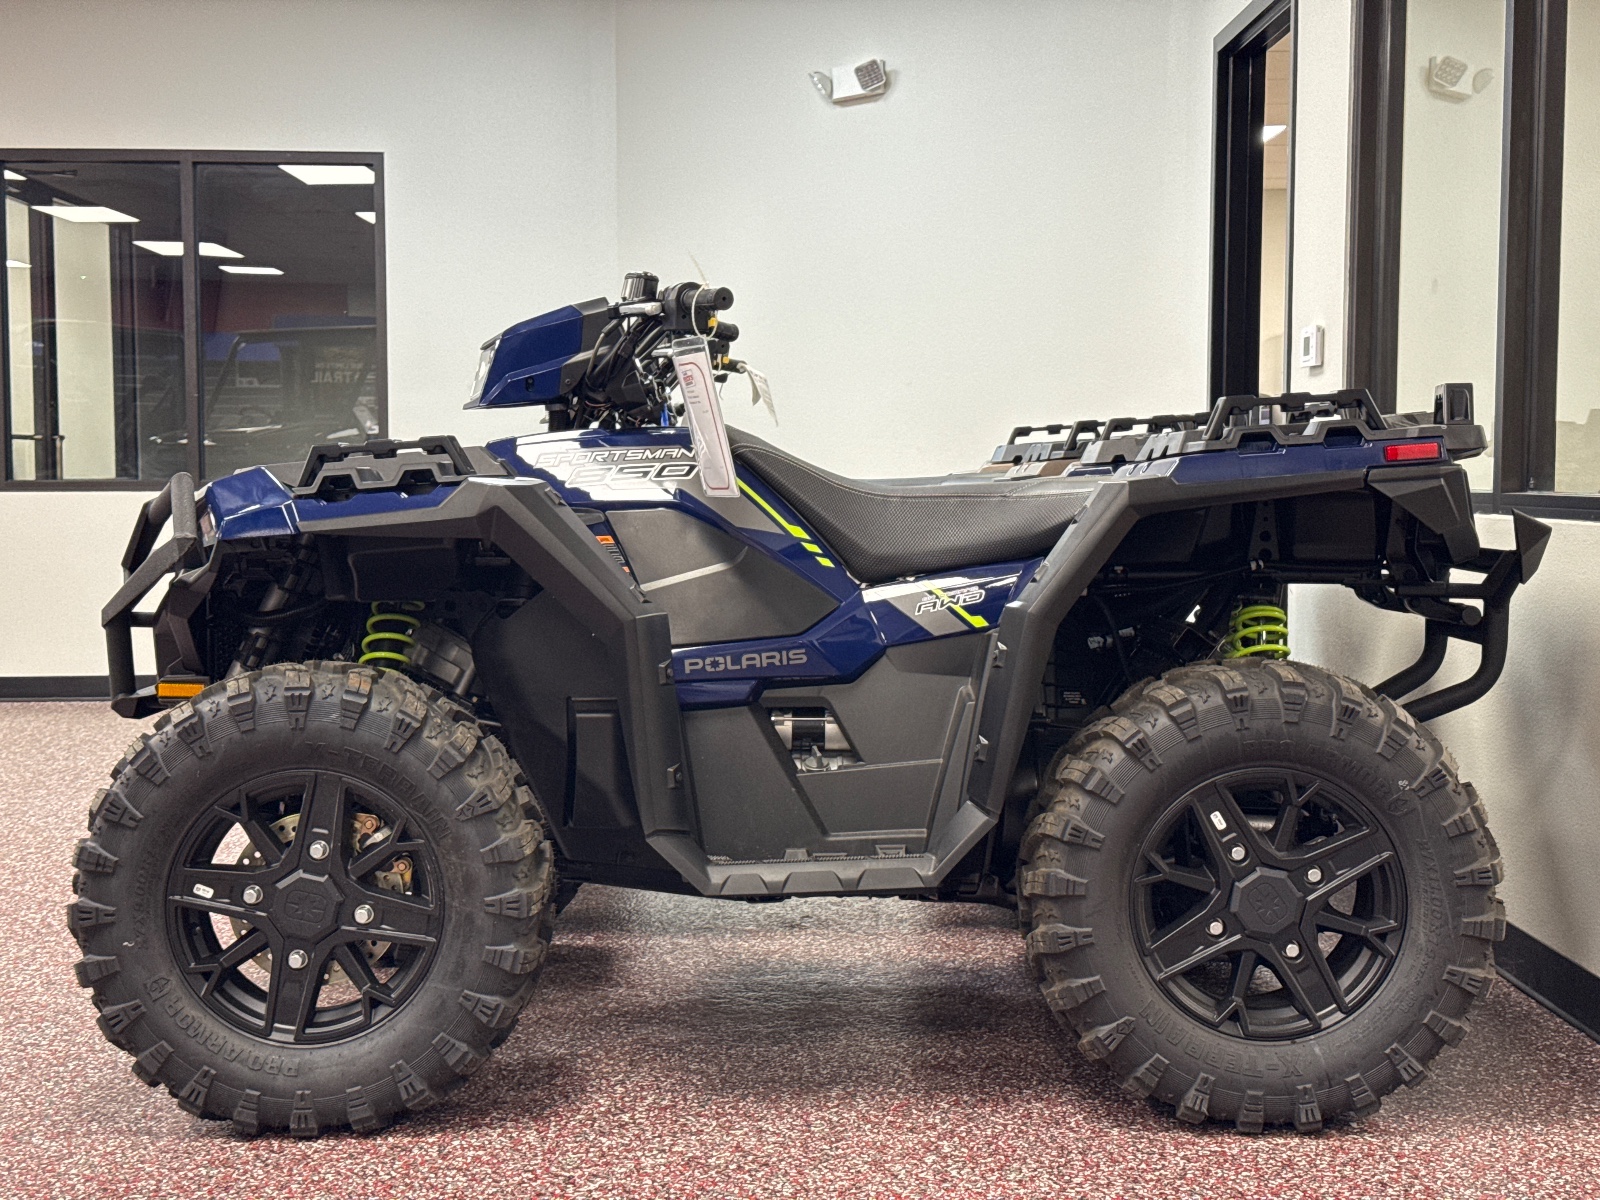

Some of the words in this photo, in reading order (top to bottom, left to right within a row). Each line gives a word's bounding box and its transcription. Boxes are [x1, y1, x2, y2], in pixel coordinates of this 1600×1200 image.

[533, 448, 697, 468] SPORTSMAN
[565, 462, 699, 487] 850
[915, 589, 985, 615] AWD
[684, 648, 808, 674] POLARIS
[304, 741, 451, 840] X-TERRAIN
[164, 998, 244, 1073] ARMOR
[1139, 1000, 1303, 1078] X-TERRAIN
[247, 1054, 300, 1077] PRO
